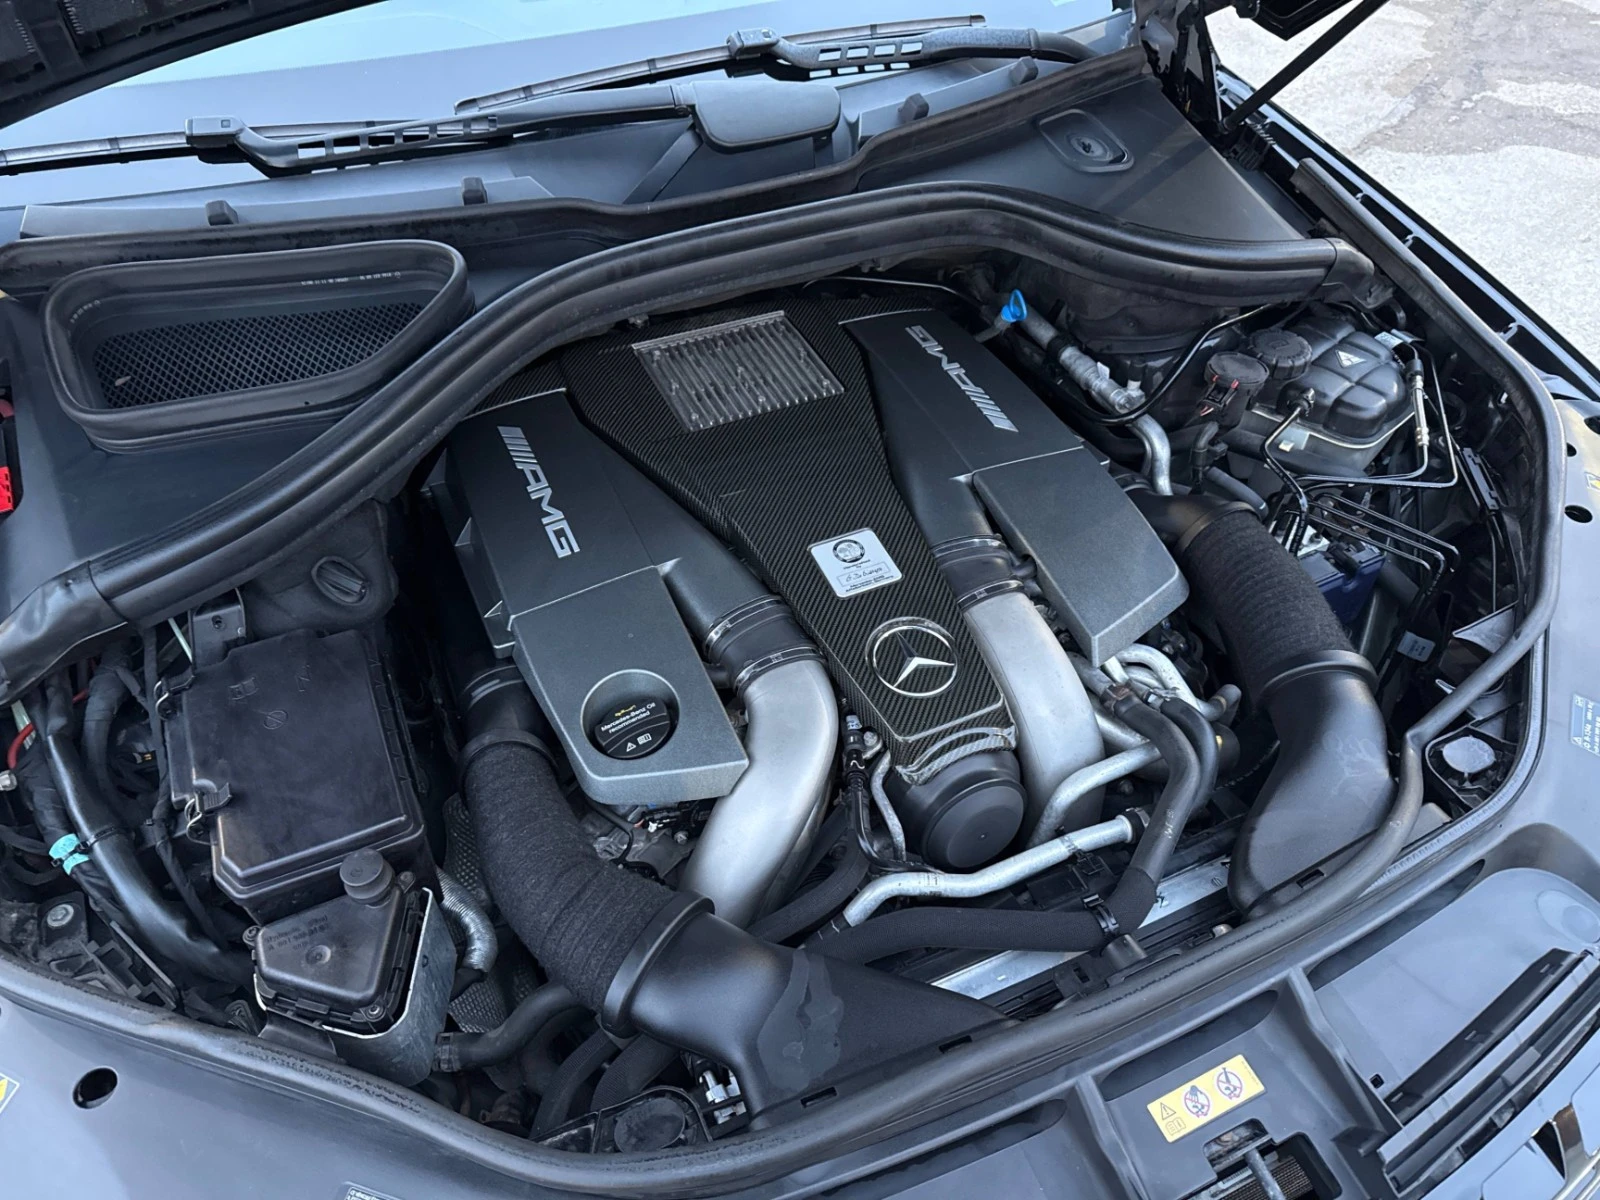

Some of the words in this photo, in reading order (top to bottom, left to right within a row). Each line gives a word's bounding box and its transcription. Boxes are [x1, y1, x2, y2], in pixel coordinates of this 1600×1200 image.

[905, 325, 986, 394] AMG
[514, 461, 581, 559] AMG
[601, 707, 646, 732] Mercedes-Benz
[646, 702, 656, 710] Oil
[608, 710, 651, 734] recommended
